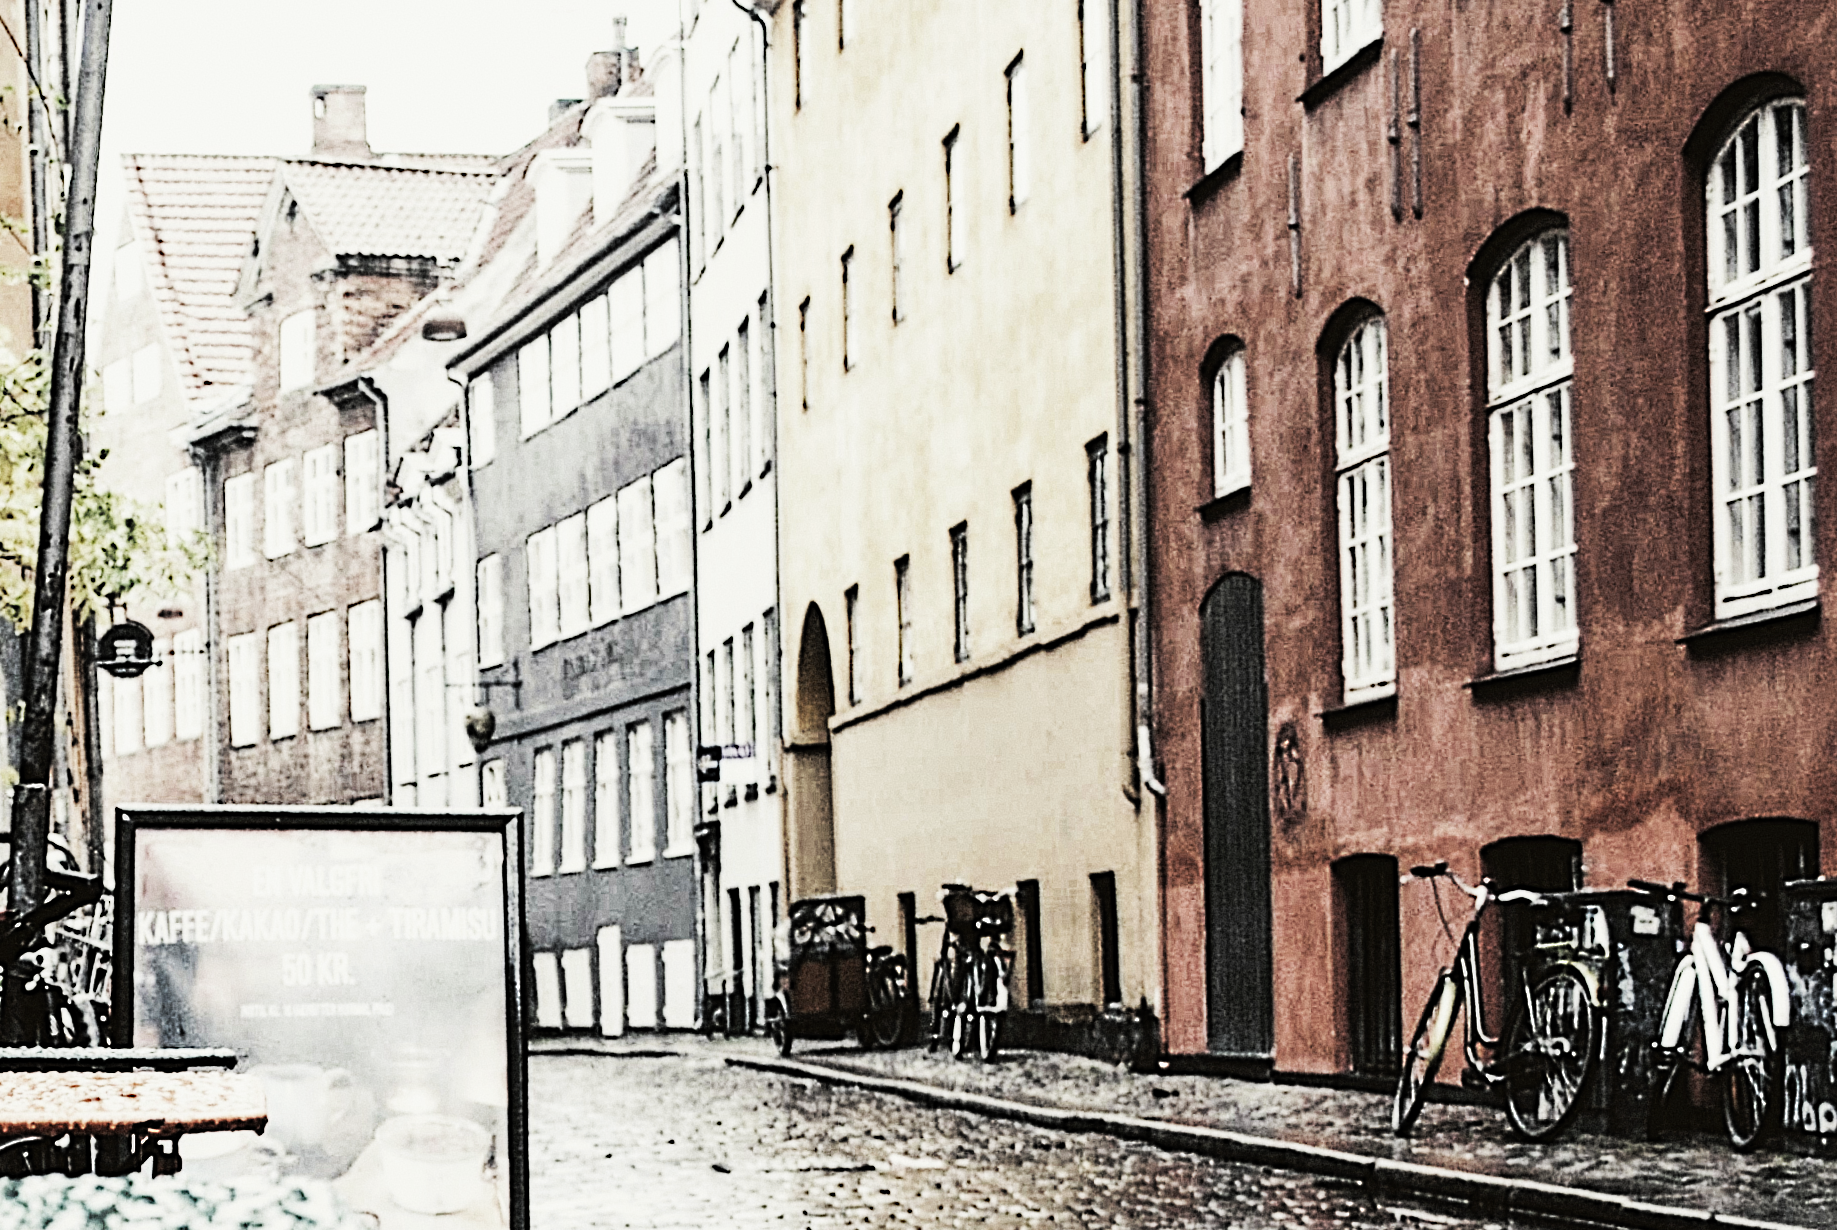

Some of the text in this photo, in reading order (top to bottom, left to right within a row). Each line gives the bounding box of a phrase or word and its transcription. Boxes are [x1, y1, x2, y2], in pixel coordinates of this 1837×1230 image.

[288, 864, 381, 898] VALGFRI
[137, 908, 359, 944] KAFFE/KAKAO/THE
[390, 907, 498, 941] TIRAMISU
[282, 952, 357, 986] 50 KR.
